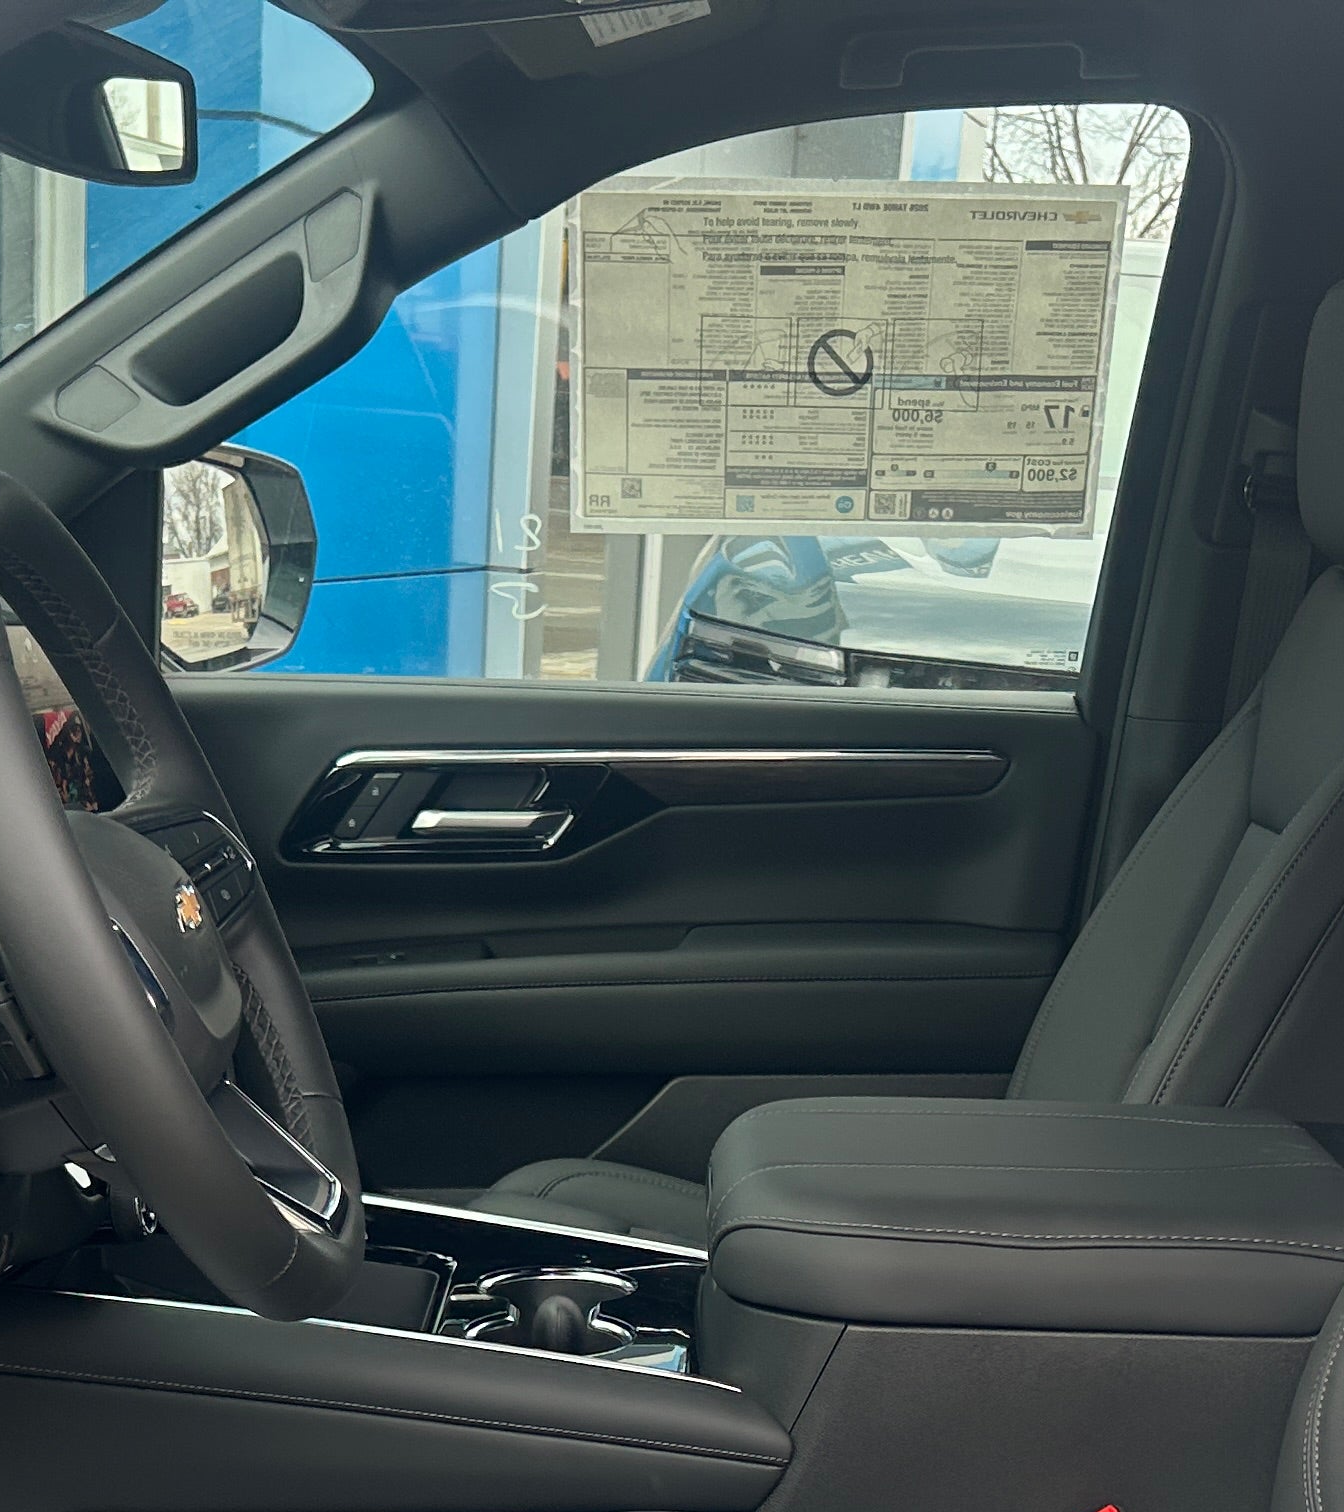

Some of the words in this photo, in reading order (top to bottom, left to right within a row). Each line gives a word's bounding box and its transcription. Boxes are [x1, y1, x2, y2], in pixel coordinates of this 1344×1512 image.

[704, 217, 713, 227] To
[716, 217, 734, 228] help
[737, 217, 760, 227] avoid
[797, 218, 829, 227] remove
